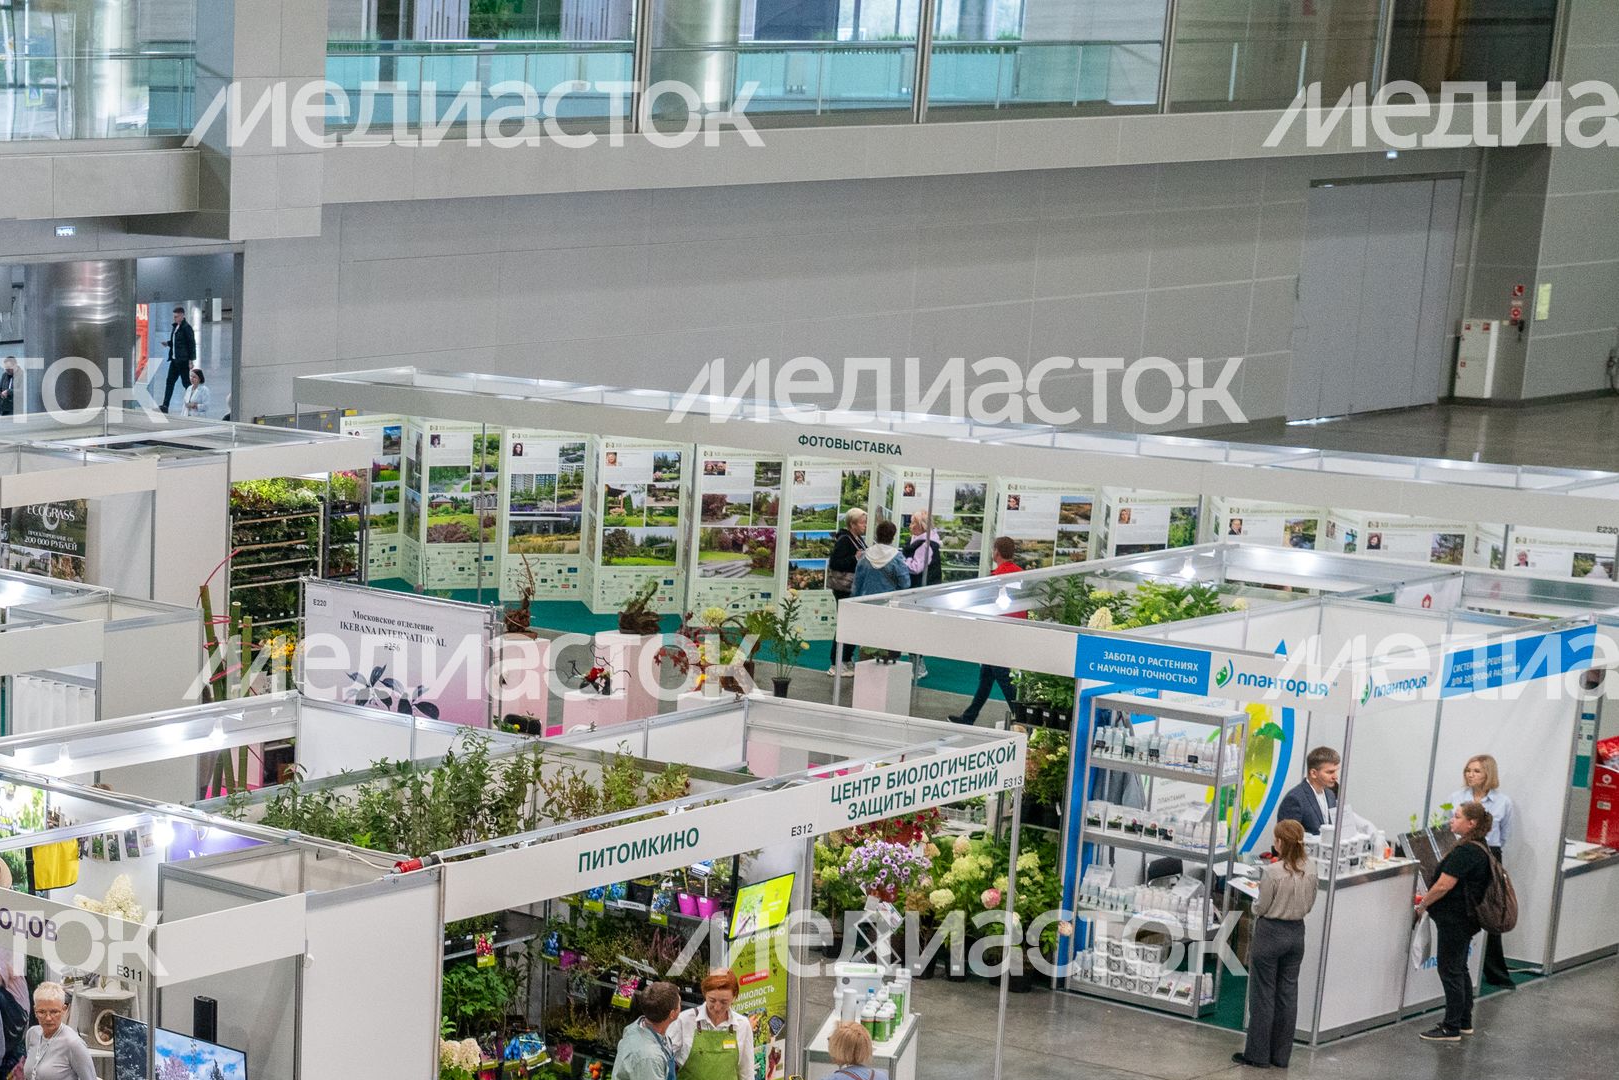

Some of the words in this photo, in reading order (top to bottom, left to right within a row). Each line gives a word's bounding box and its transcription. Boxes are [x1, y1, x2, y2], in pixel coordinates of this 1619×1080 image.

[797, 433, 903, 456] ФОТОВЫСТАВКА
[312, 598, 327, 607] E220
[352, 610, 396, 626] Московское
[340, 621, 377, 636] IKEBANA
[377, 627, 447, 648] INTERNATIONAL
[1103, 650, 1136, 664] ЗАБОТА
[1138, 654, 1145, 664] О
[1147, 656, 1199, 672] РАСТЕНИЯХ
[1097, 663, 1140, 679] НАУЧНОЙ
[1141, 669, 1198, 685] ТОЧНОСТЬЮ
[830, 775, 881, 805] ЦЕНТР
[886, 741, 1017, 790] БИОЛОГИЧЕСКОЙ
[1003, 776, 1024, 790] E313
[847, 789, 915, 822] ЗАЩИТЫ
[921, 768, 999, 809] РАСТЕНИЙ
[790, 823, 813, 839] E312
[577, 826, 700, 874] ПИТОМКИНО
[116, 964, 144, 983] E311
[735, 985, 776, 1003] ИМОЛОСТЬ
